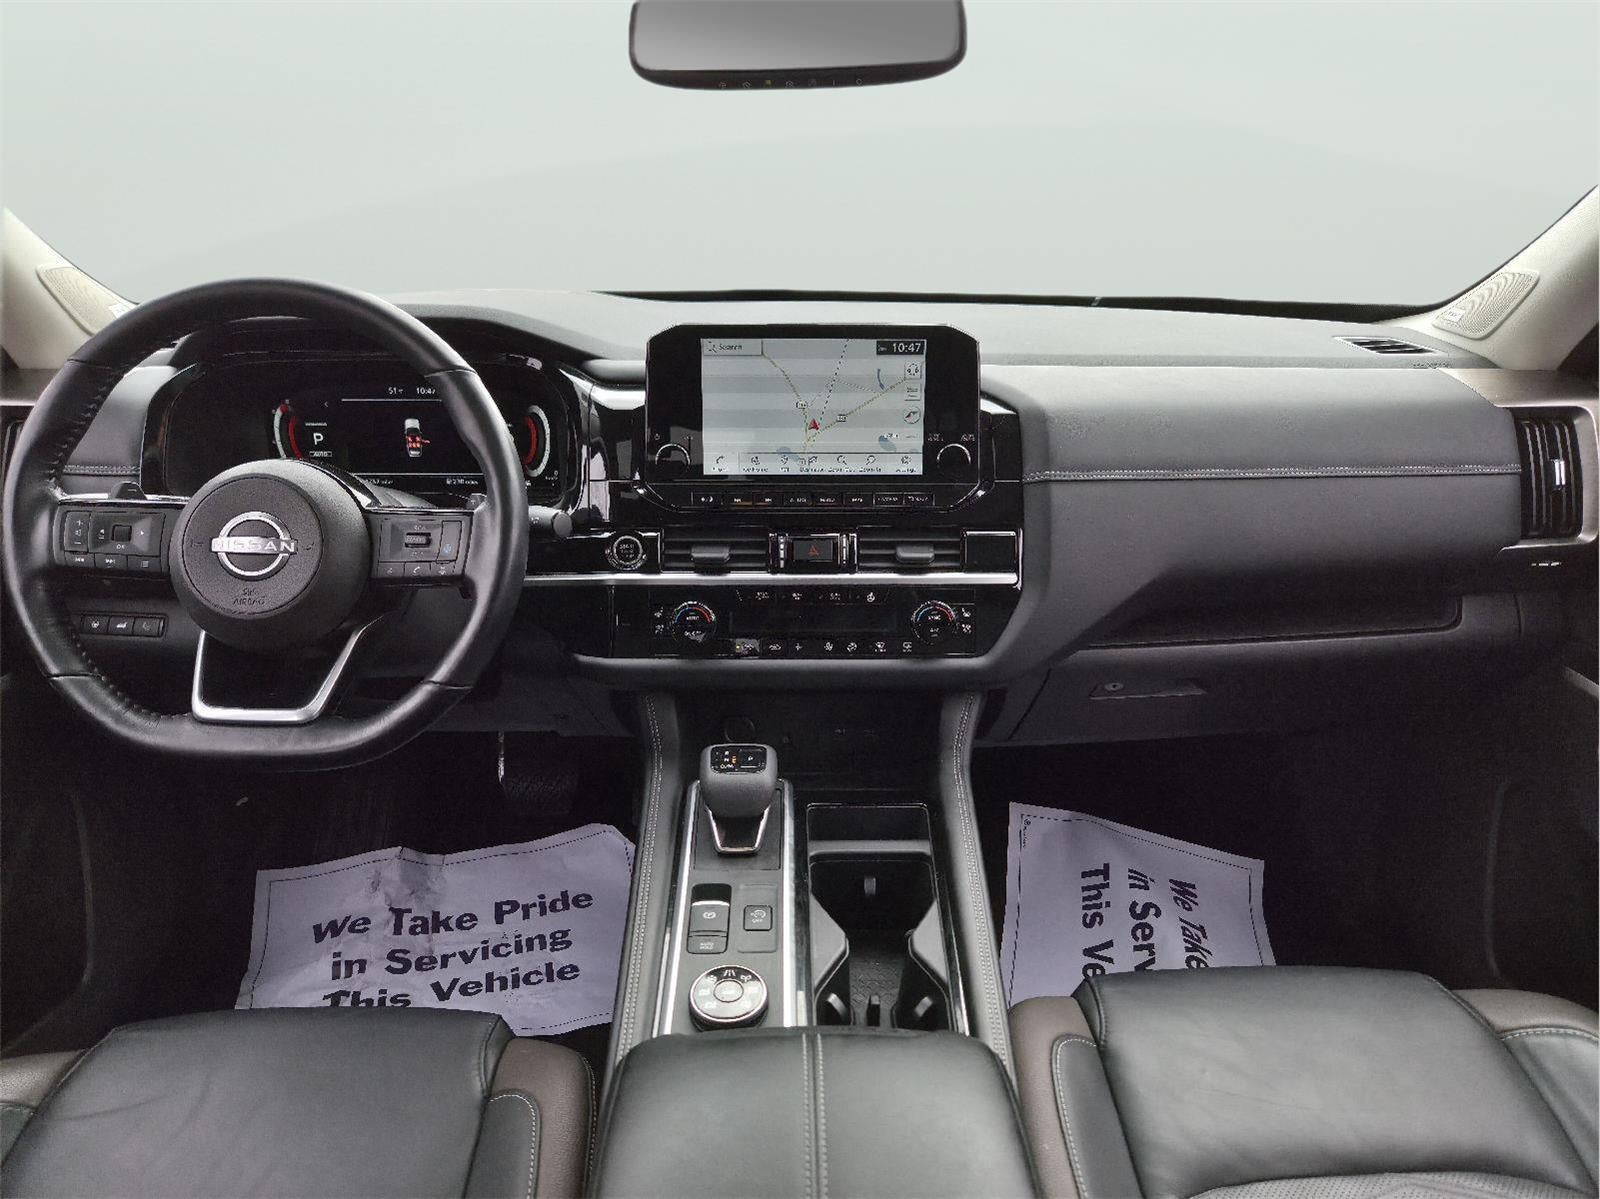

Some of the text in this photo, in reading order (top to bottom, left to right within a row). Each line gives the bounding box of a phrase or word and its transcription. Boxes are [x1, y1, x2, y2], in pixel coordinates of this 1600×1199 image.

[892, 342, 922, 353] 10:47
[313, 432, 324, 446] P
[213, 540, 295, 552] NISSAN
[1080, 862, 1111, 929] This
[1128, 868, 1156, 891] in
[312, 889, 594, 944] We Take Pride
[1168, 878, 1213, 969] We Take
[330, 927, 573, 981] in Servicing
[322, 960, 581, 1008] This Vehicle
